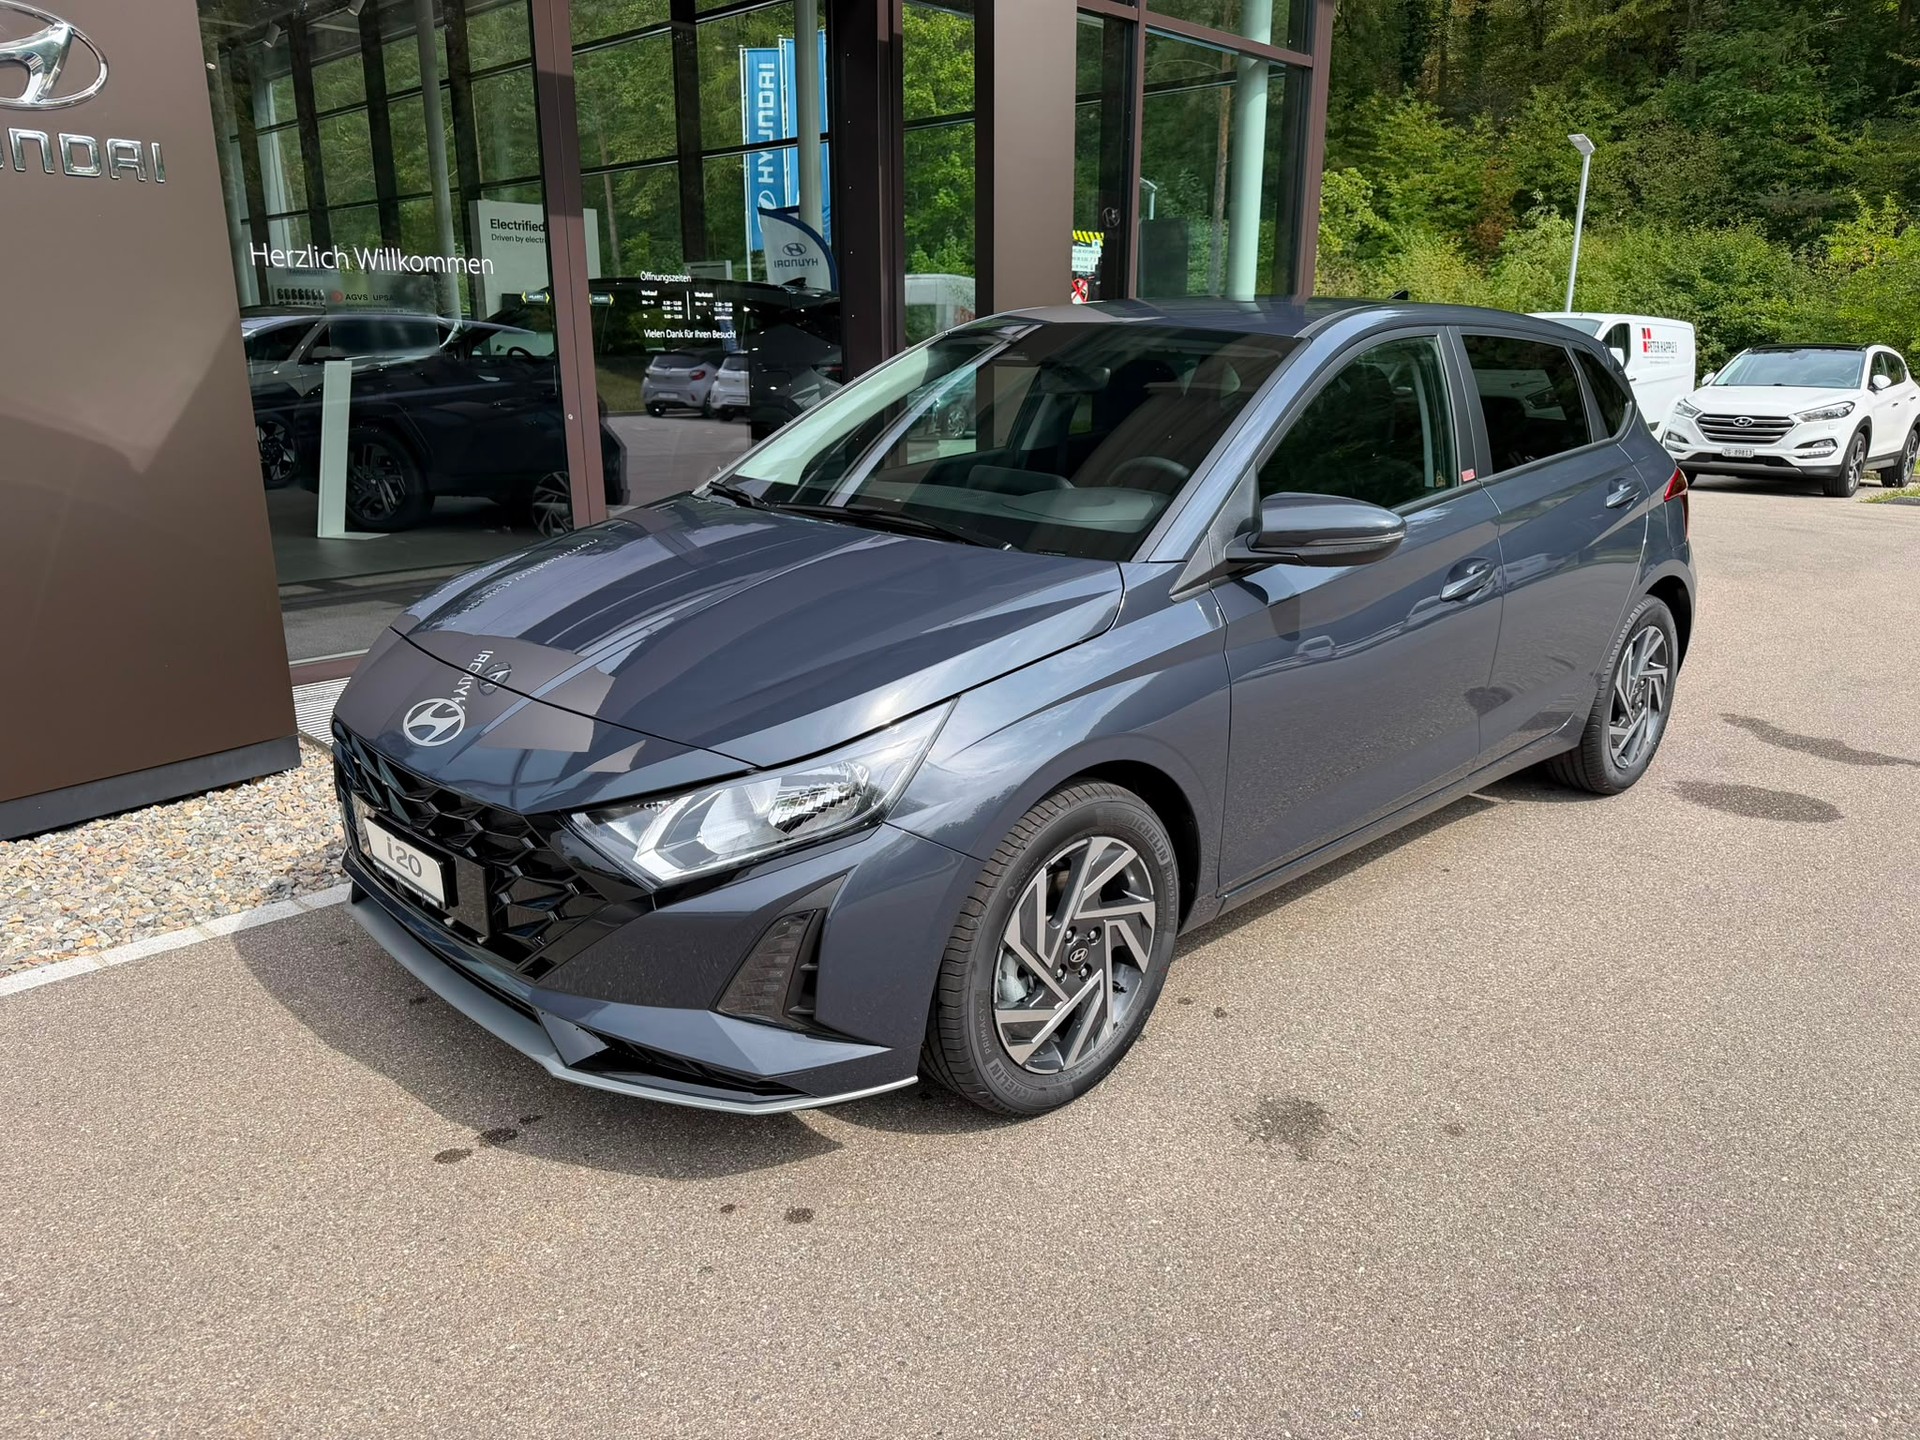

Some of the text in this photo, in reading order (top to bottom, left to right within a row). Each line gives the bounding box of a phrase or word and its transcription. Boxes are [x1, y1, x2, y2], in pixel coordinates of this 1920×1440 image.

[0, 127, 166, 183] NDAI
[490, 219, 546, 232] Electrified
[491, 233, 514, 242] Driven
[515, 235, 524, 244] by
[250, 242, 493, 275] Herzlich Willkommen
[640, 271, 692, 283] Öffnungszeiten
[644, 329, 665, 338] Vielen
[666, 330, 683, 338] Dank
[684, 329, 694, 338] für
[695, 330, 711, 338] Ihren
[386, 836, 422, 878] i20
